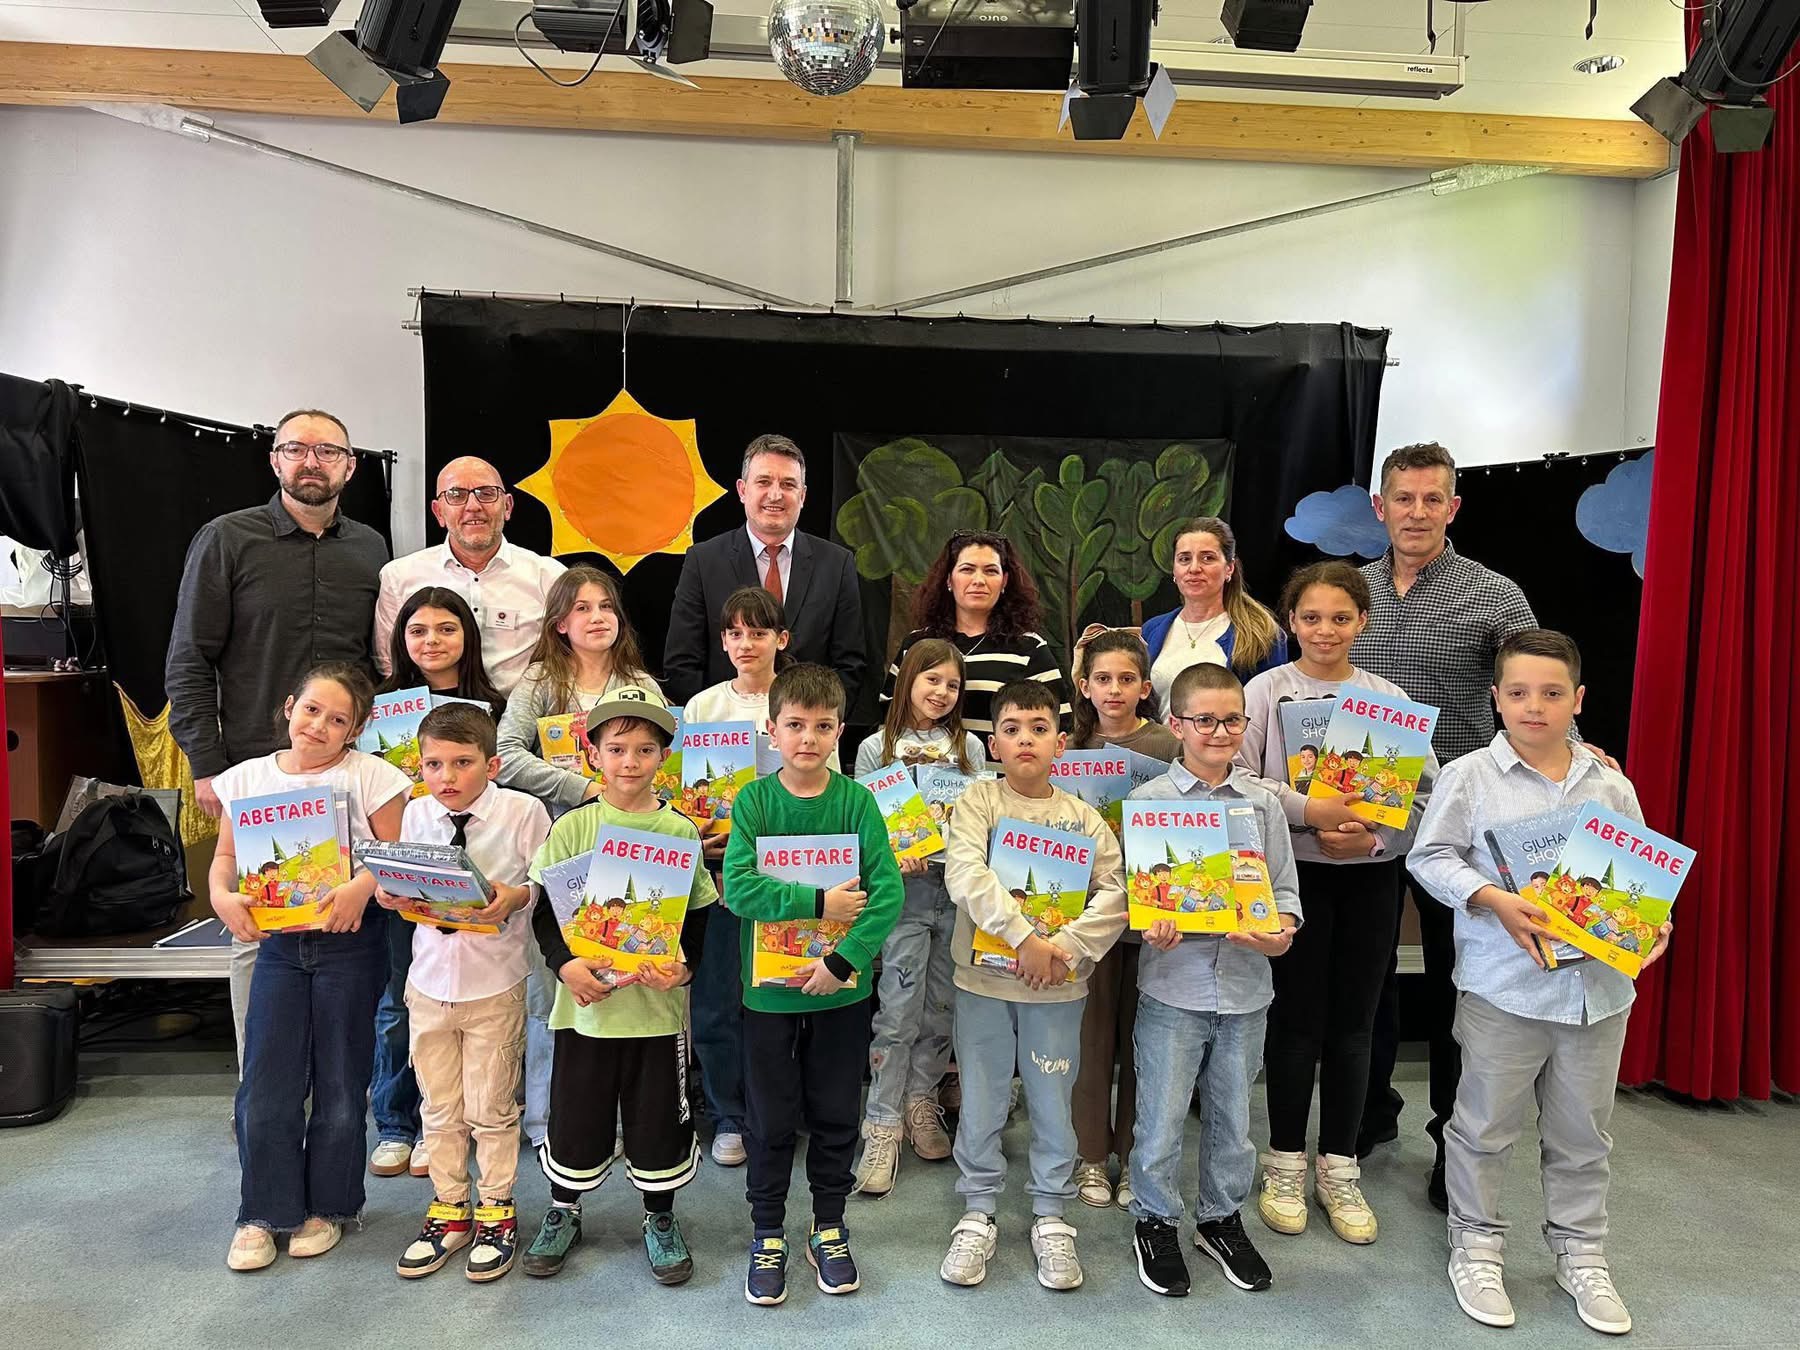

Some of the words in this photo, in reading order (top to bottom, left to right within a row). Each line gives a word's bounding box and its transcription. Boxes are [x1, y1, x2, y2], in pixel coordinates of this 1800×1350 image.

[370, 697, 426, 720] ETARE
[1341, 697, 1430, 733] ABETARE
[682, 731, 750, 748] ABETARE
[1049, 760, 1125, 777] ABETARE
[867, 770, 906, 793] TARE
[239, 799, 327, 827] ABETARE
[1131, 812, 1221, 828] ABETARE
[601, 838, 693, 870] ABETARE
[1002, 830, 1090, 865] ABETARE
[1522, 832, 1568, 853] GJUHA
[1584, 816, 1685, 875] ABETARE
[763, 847, 854, 868] ABETARE
[378, 869, 471, 890] ABETARE
